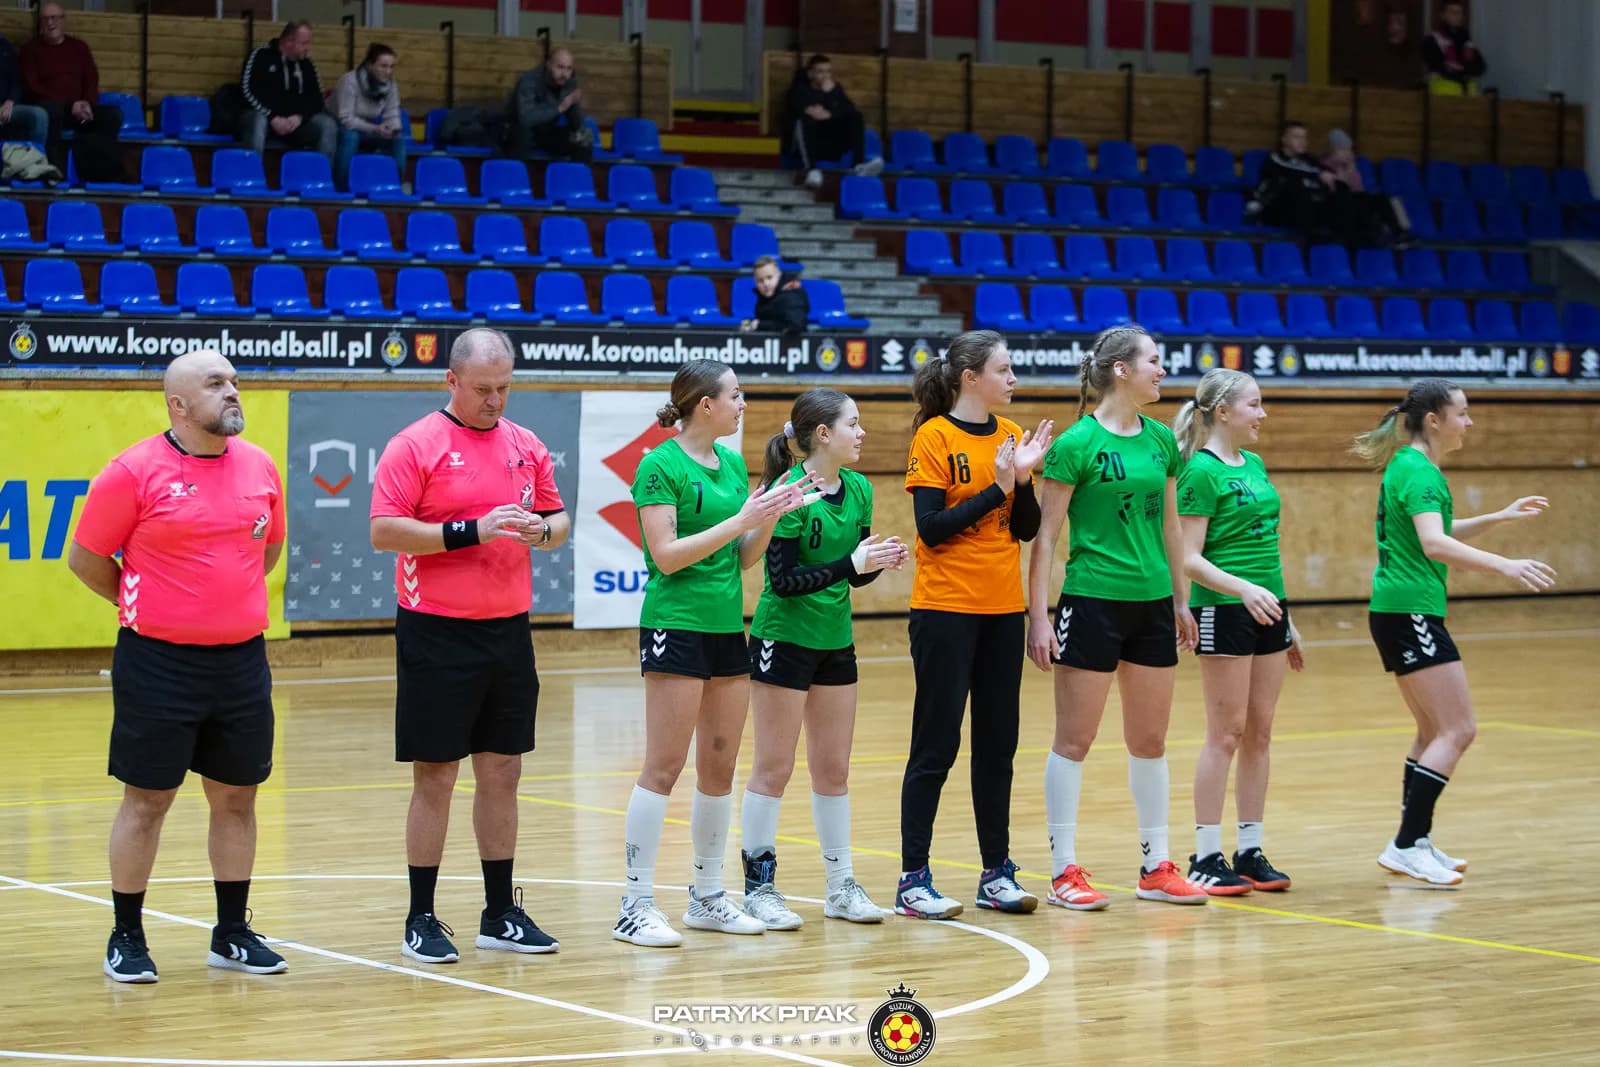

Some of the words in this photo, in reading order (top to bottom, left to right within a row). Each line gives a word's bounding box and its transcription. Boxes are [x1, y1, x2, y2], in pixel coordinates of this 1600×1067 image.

[46, 327, 372, 367] www.koronahandball.pl
[521, 335, 809, 372] www.koronahandball.pl
[1304, 346, 1527, 377] www.koronahandball.pl
[946, 452, 972, 485] 16
[1097, 451, 1127, 483] 20
[691, 481, 703, 514] 7
[1228, 479, 1258, 507] 24
[809, 516, 823, 549] 8
